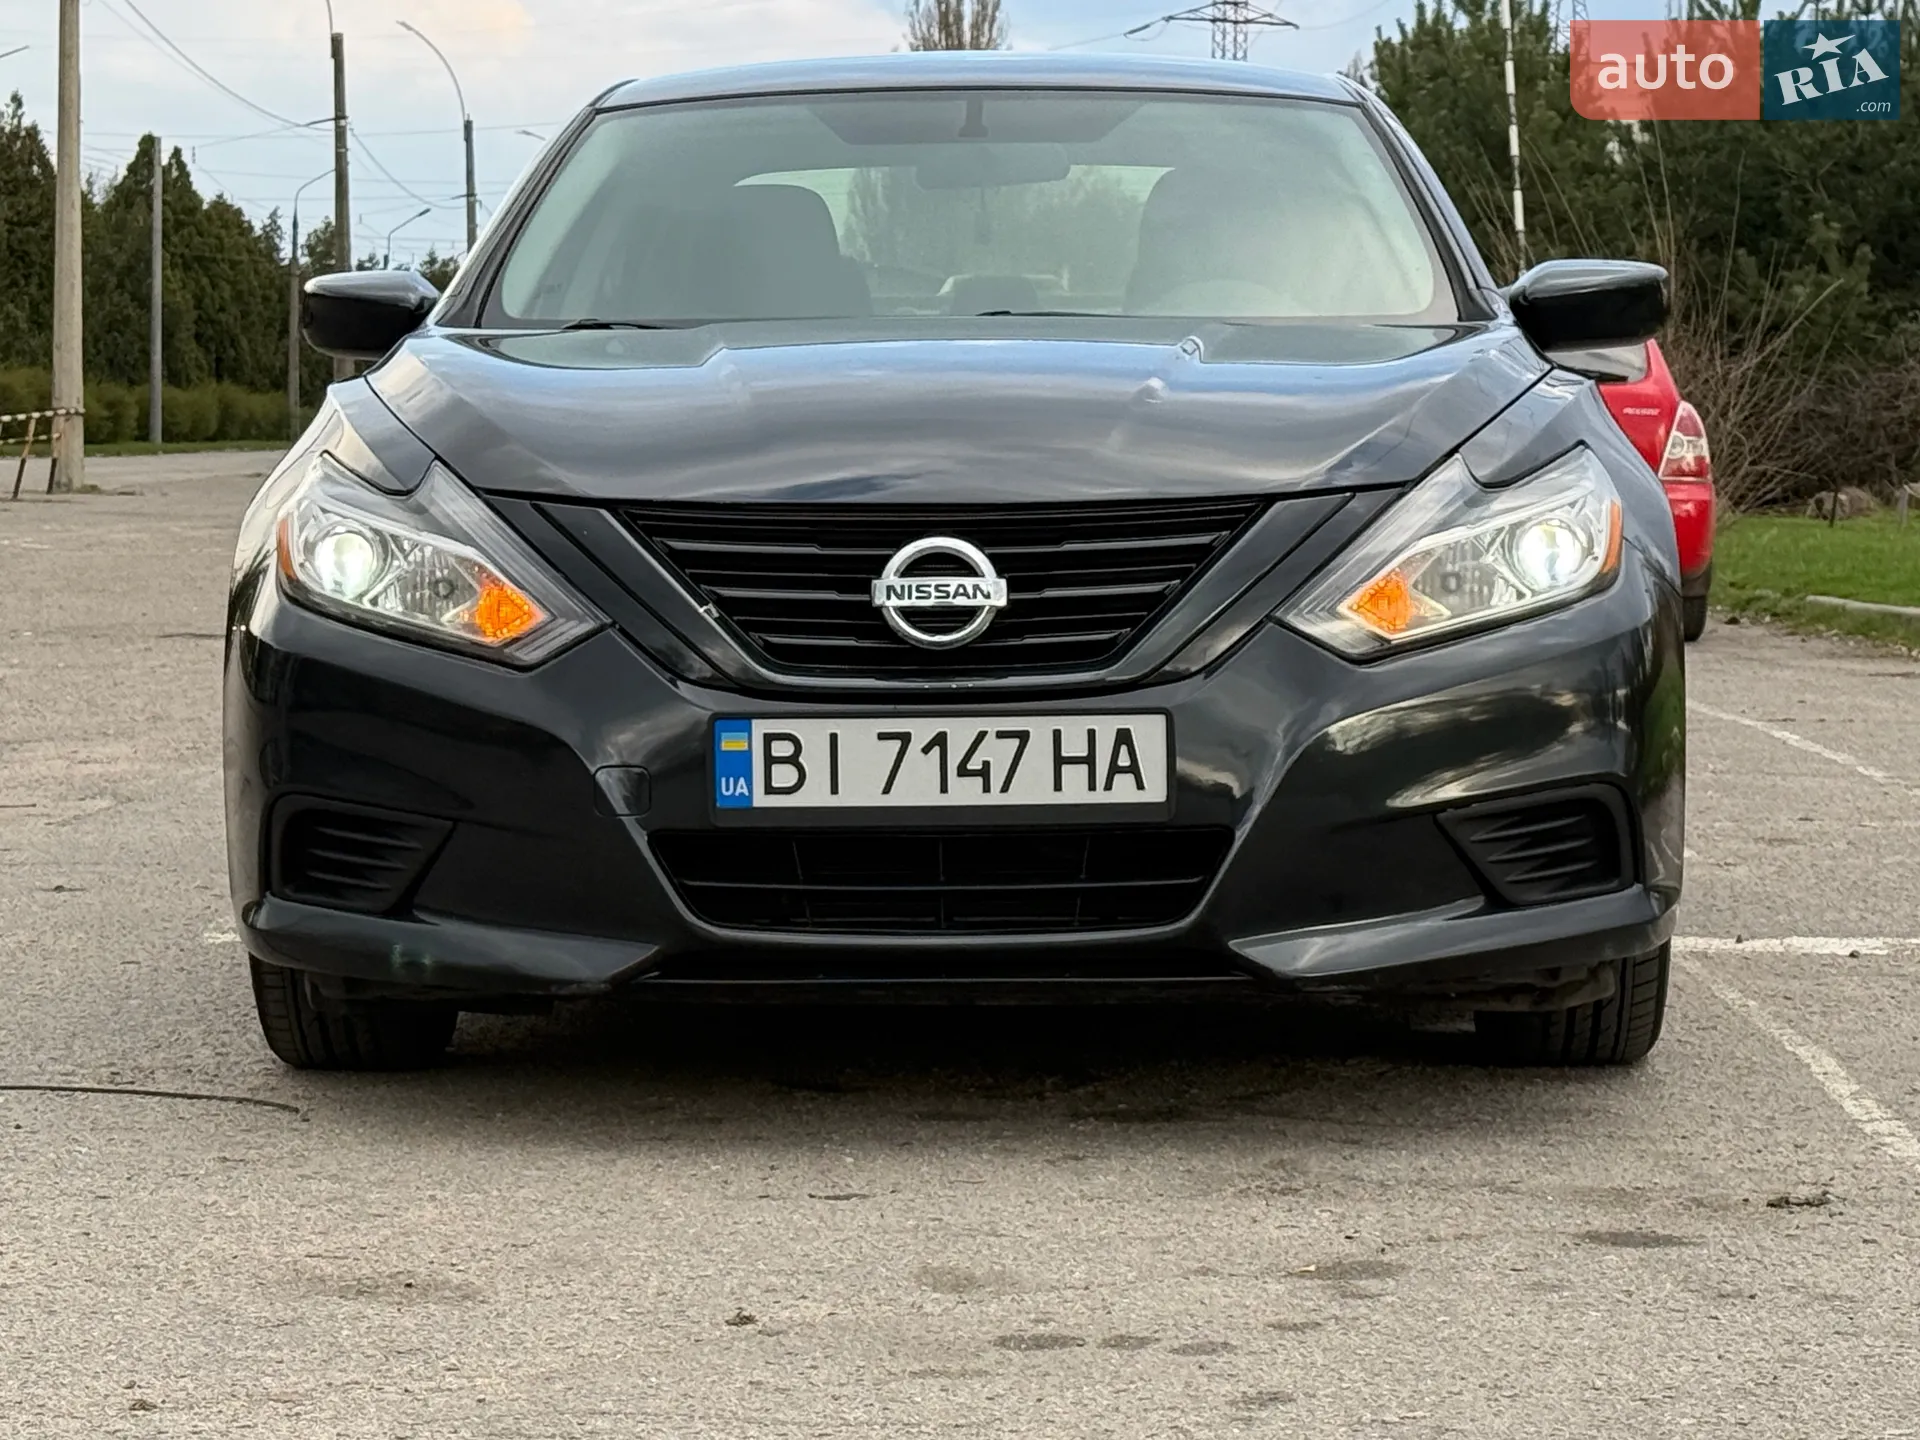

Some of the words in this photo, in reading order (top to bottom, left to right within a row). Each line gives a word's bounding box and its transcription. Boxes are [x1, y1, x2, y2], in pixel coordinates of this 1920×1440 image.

[885, 583, 992, 601] NISSAN
[762, 731, 840, 796] BI
[876, 729, 1031, 795] 7147
[1052, 727, 1147, 793] HA
[720, 776, 750, 797] UA
